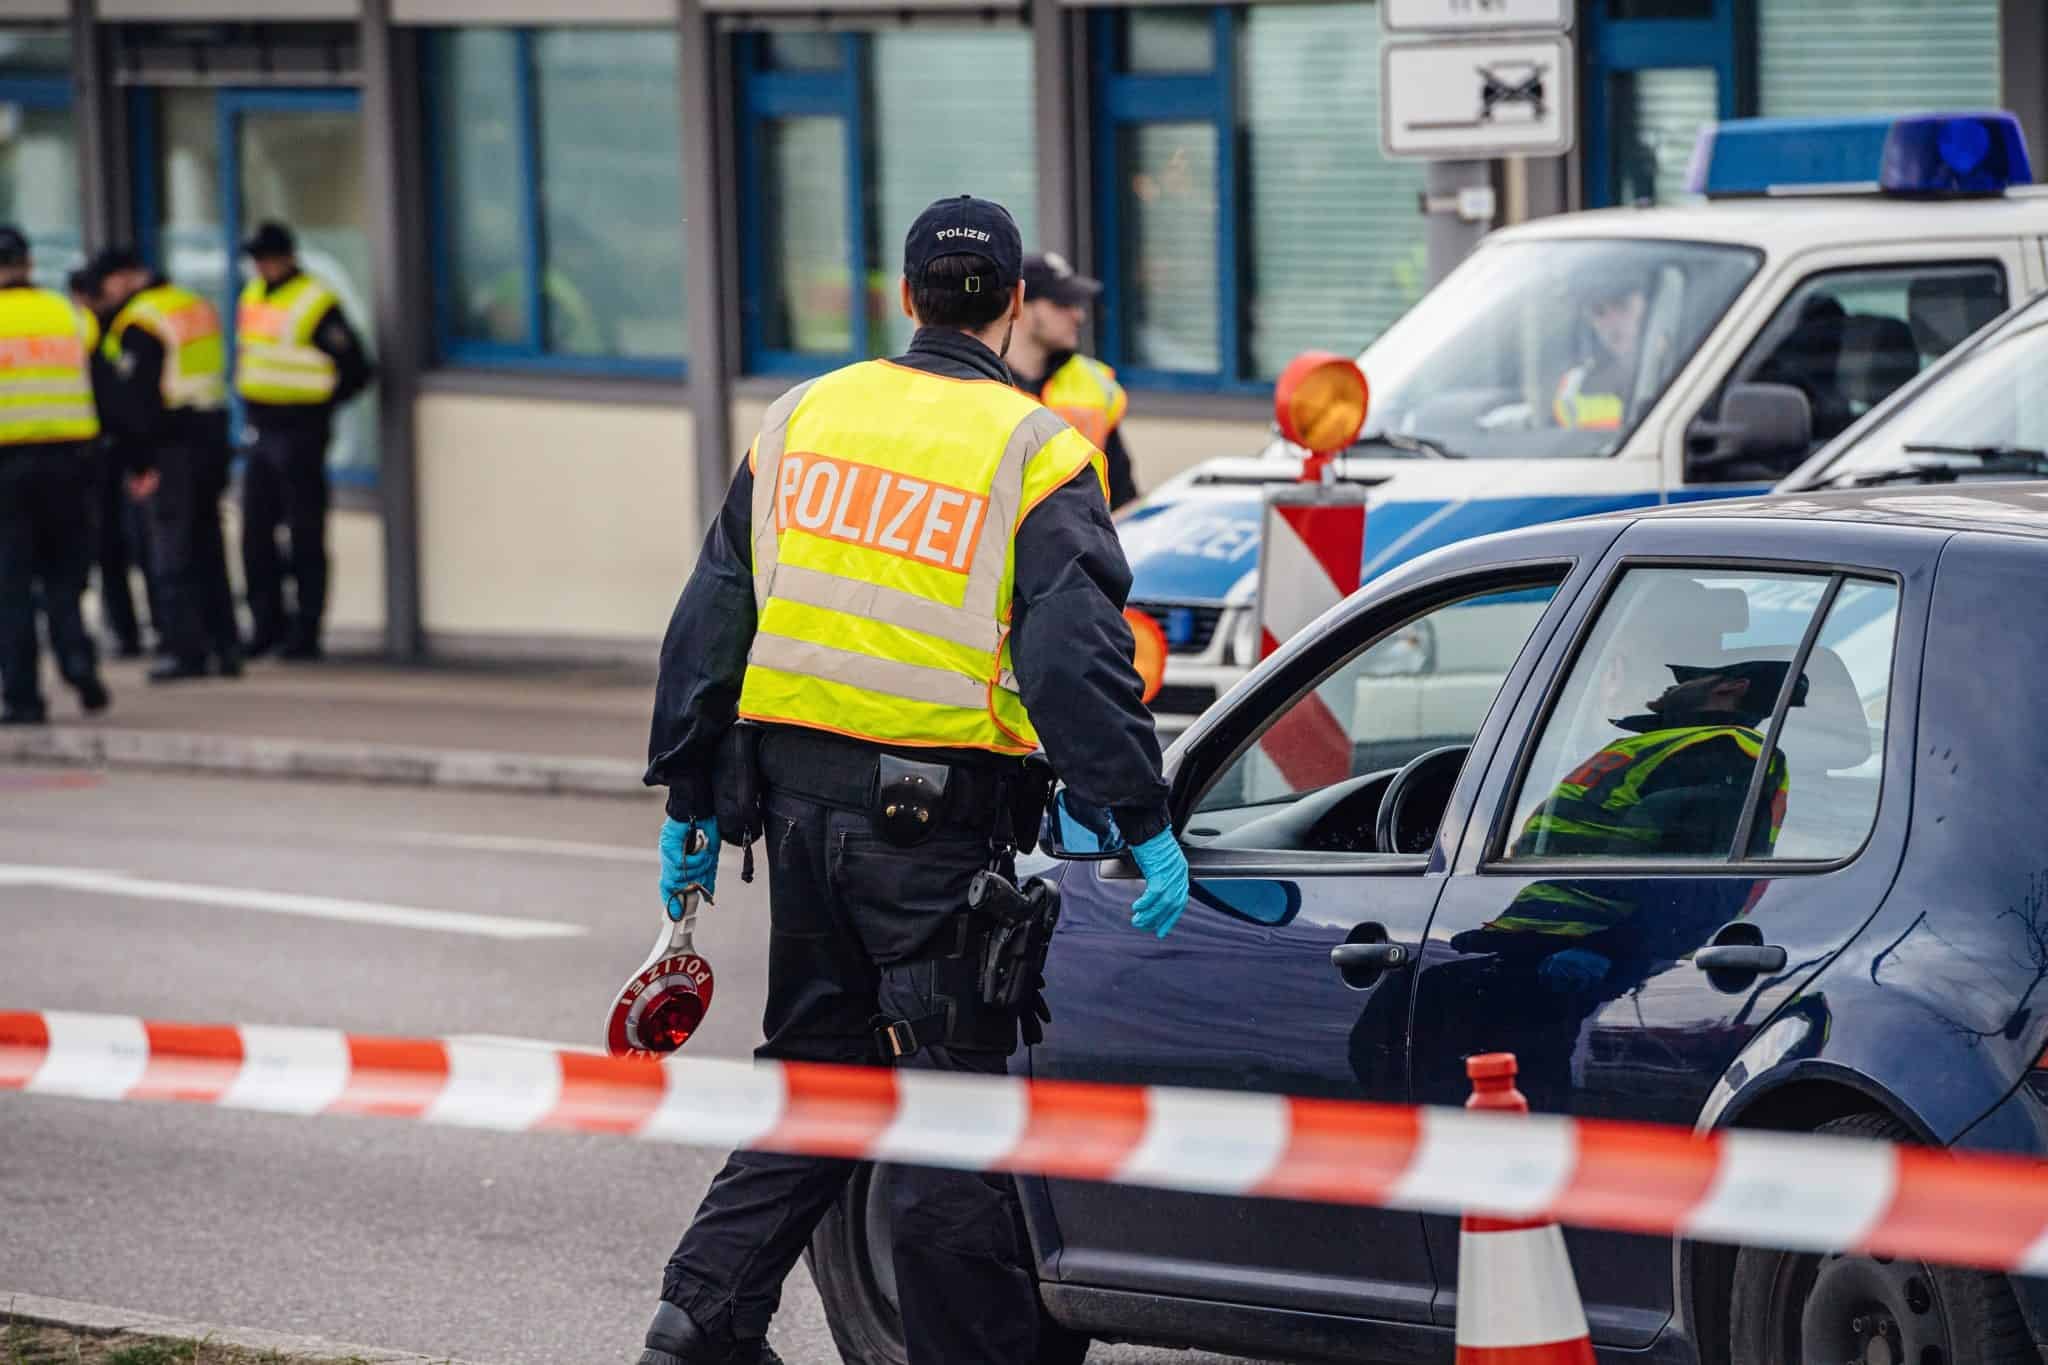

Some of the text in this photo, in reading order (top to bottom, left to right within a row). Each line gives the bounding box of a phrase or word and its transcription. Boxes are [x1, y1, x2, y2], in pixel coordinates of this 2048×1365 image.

[935, 227, 991, 242] POLIZEI
[779, 457, 983, 568] POLIZEI
[620, 956, 711, 1005] POLIZEI
